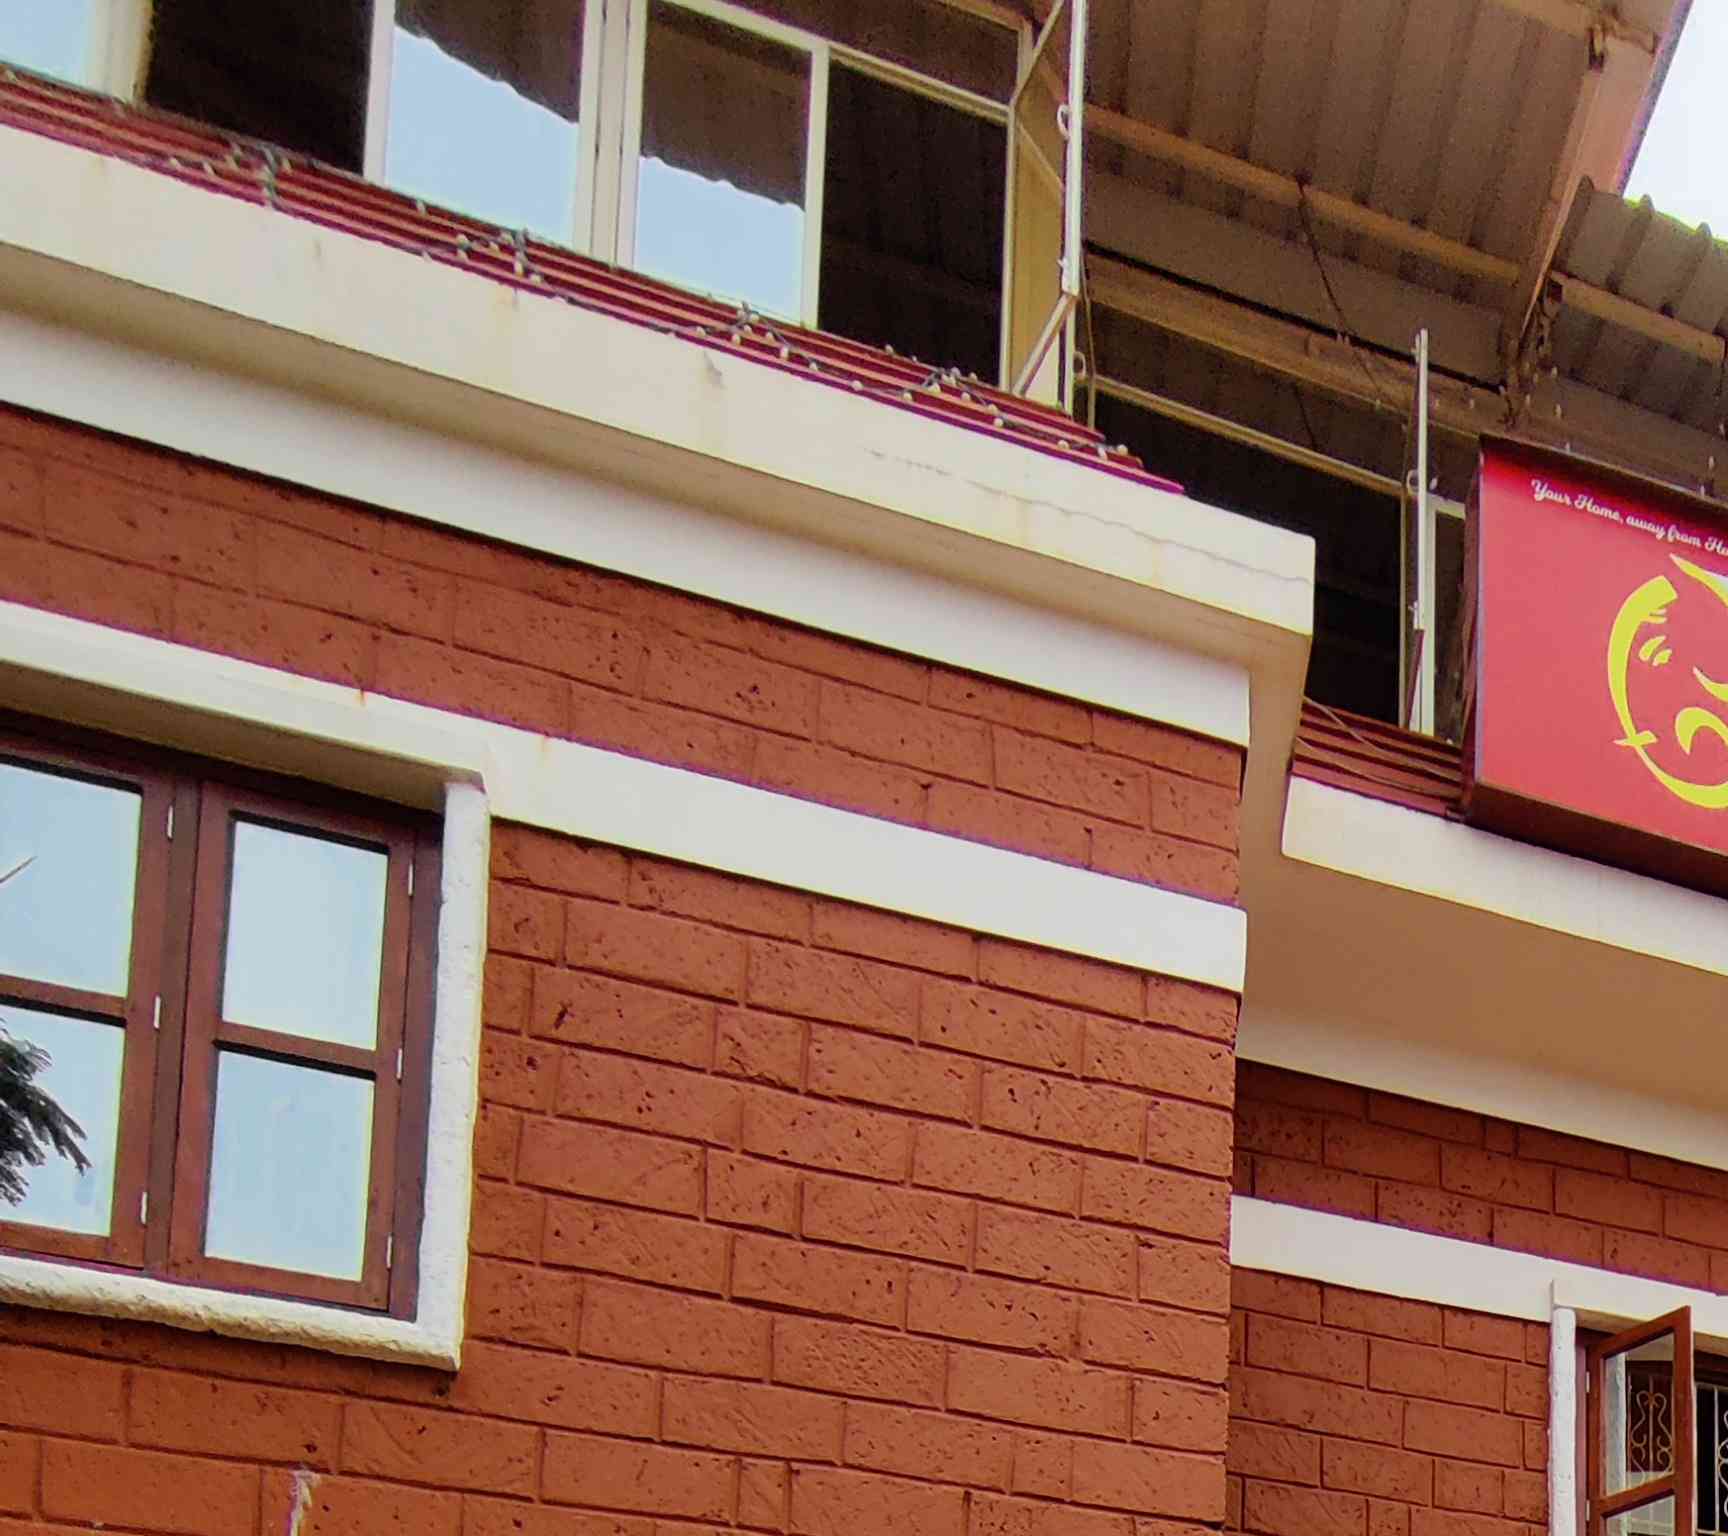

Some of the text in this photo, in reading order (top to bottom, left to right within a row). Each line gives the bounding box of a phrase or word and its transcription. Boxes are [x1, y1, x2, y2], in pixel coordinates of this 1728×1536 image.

[1531, 479, 1572, 505] Your
[1575, 494, 1624, 524] Home,
[1626, 515, 1666, 539] away
[1667, 524, 1702, 548] from
